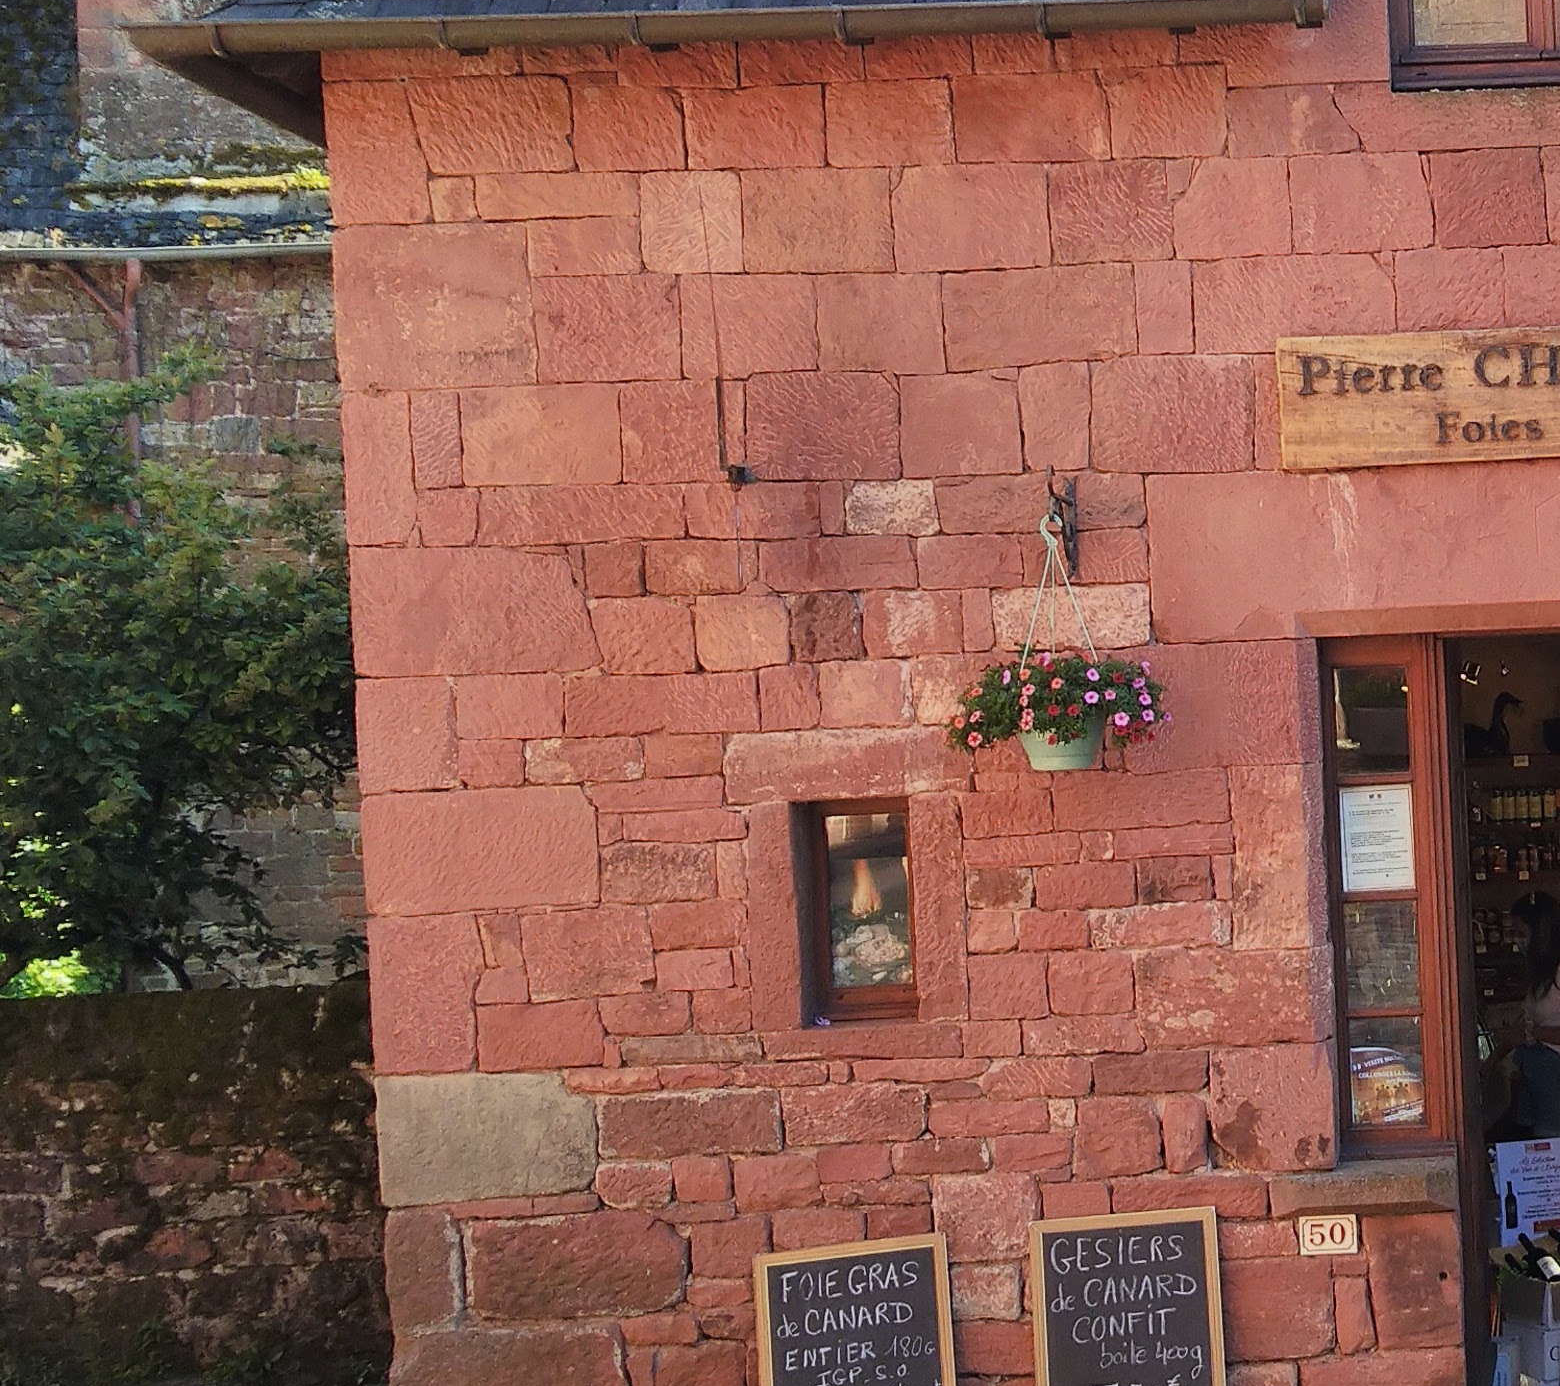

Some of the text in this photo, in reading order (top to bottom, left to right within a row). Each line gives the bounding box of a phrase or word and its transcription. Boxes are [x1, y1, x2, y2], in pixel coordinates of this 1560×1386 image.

[1299, 355, 1443, 397] Pierre
[1436, 409, 1544, 444] Foies
[1310, 1222, 1346, 1246] 50
[780, 1261, 920, 1304] FOIE GRAS
[1051, 1273, 1197, 1313] de CANARD
[777, 1301, 914, 1339] de CANARD
[1072, 1304, 1177, 1344] CONFIT
[1155, 1341, 1204, 1380] 400g
